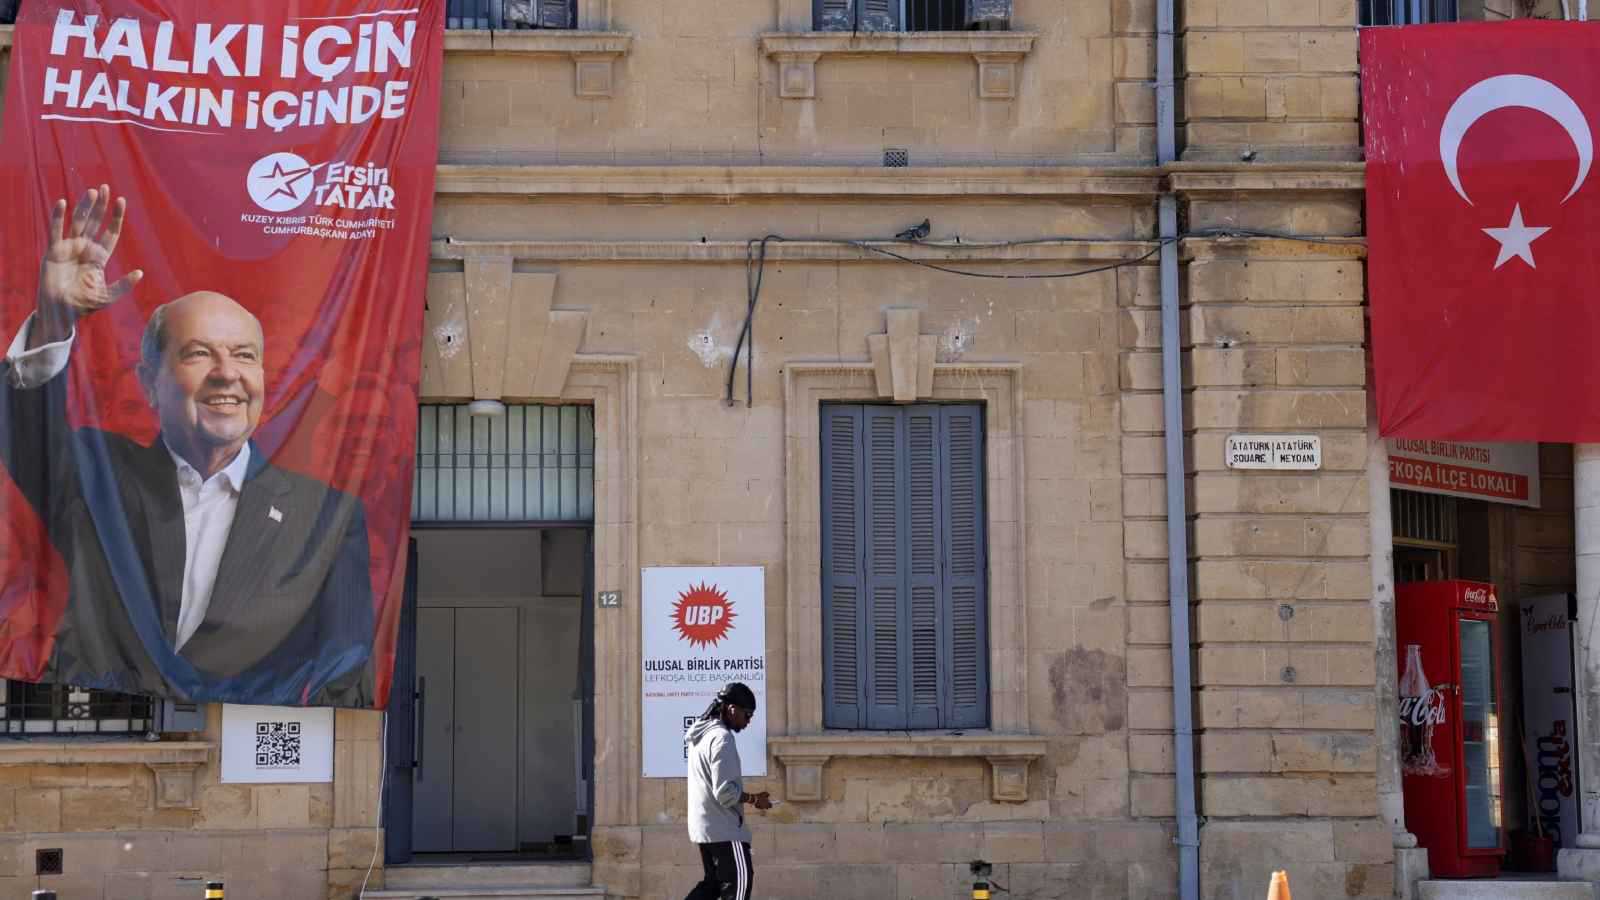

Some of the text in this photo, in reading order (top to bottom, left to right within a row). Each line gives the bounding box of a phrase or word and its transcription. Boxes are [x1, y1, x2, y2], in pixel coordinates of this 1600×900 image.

[50, 9, 262, 77] HALKI
[42, 67, 233, 128] HALKIN
[326, 161, 388, 186] Ersin
[314, 184, 395, 210] TATAR
[241, 213, 274, 224] KUZEY
[276, 215, 306, 225] KIBRIS
[309, 214, 334, 227] TÜRK
[263, 226, 376, 240] CUMHURBAŞKANI ADAYI
[1233, 454, 1267, 463] SQUARE
[1280, 454, 1315, 463] MEYDANI
[1436, 464, 1468, 489] İLÇE
[1470, 472, 1517, 496] LOKALİ
[600, 593, 617, 605] 12
[684, 605, 724, 625] UBP
[645, 656, 764, 671] ULUSAL BİRLİK PARTİSİ
[645, 673, 685, 683] LEFKOŞA
[687, 673, 706, 682] İLÇE
